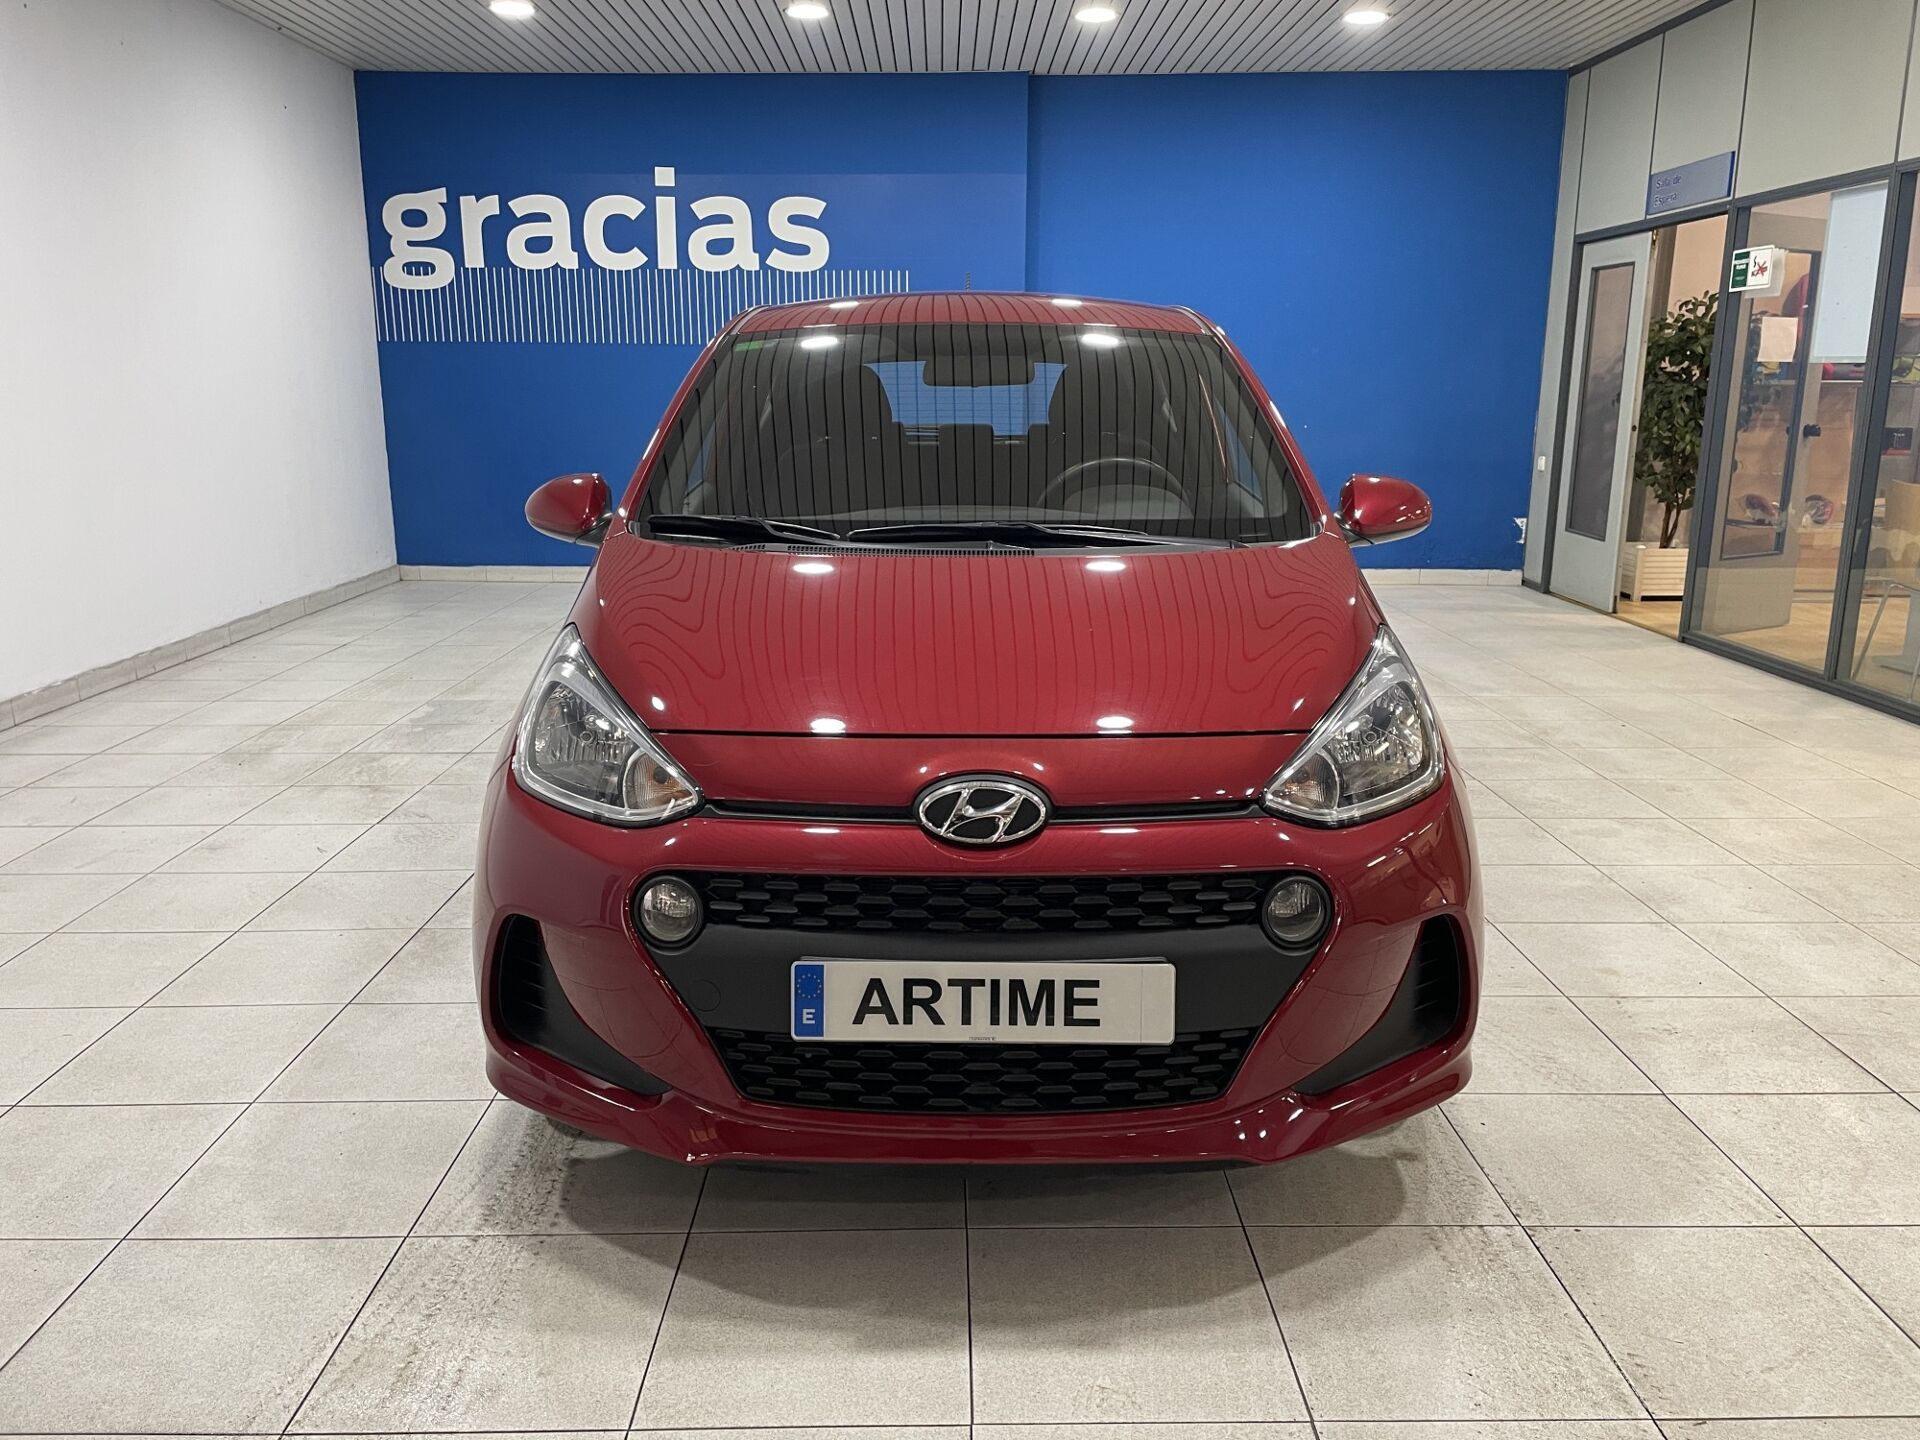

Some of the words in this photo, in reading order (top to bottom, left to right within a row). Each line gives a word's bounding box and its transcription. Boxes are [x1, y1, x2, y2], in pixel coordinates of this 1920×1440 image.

[382, 166, 832, 290] gracias
[802, 1008, 816, 1025] E
[852, 977, 1101, 1027] ARTIME
